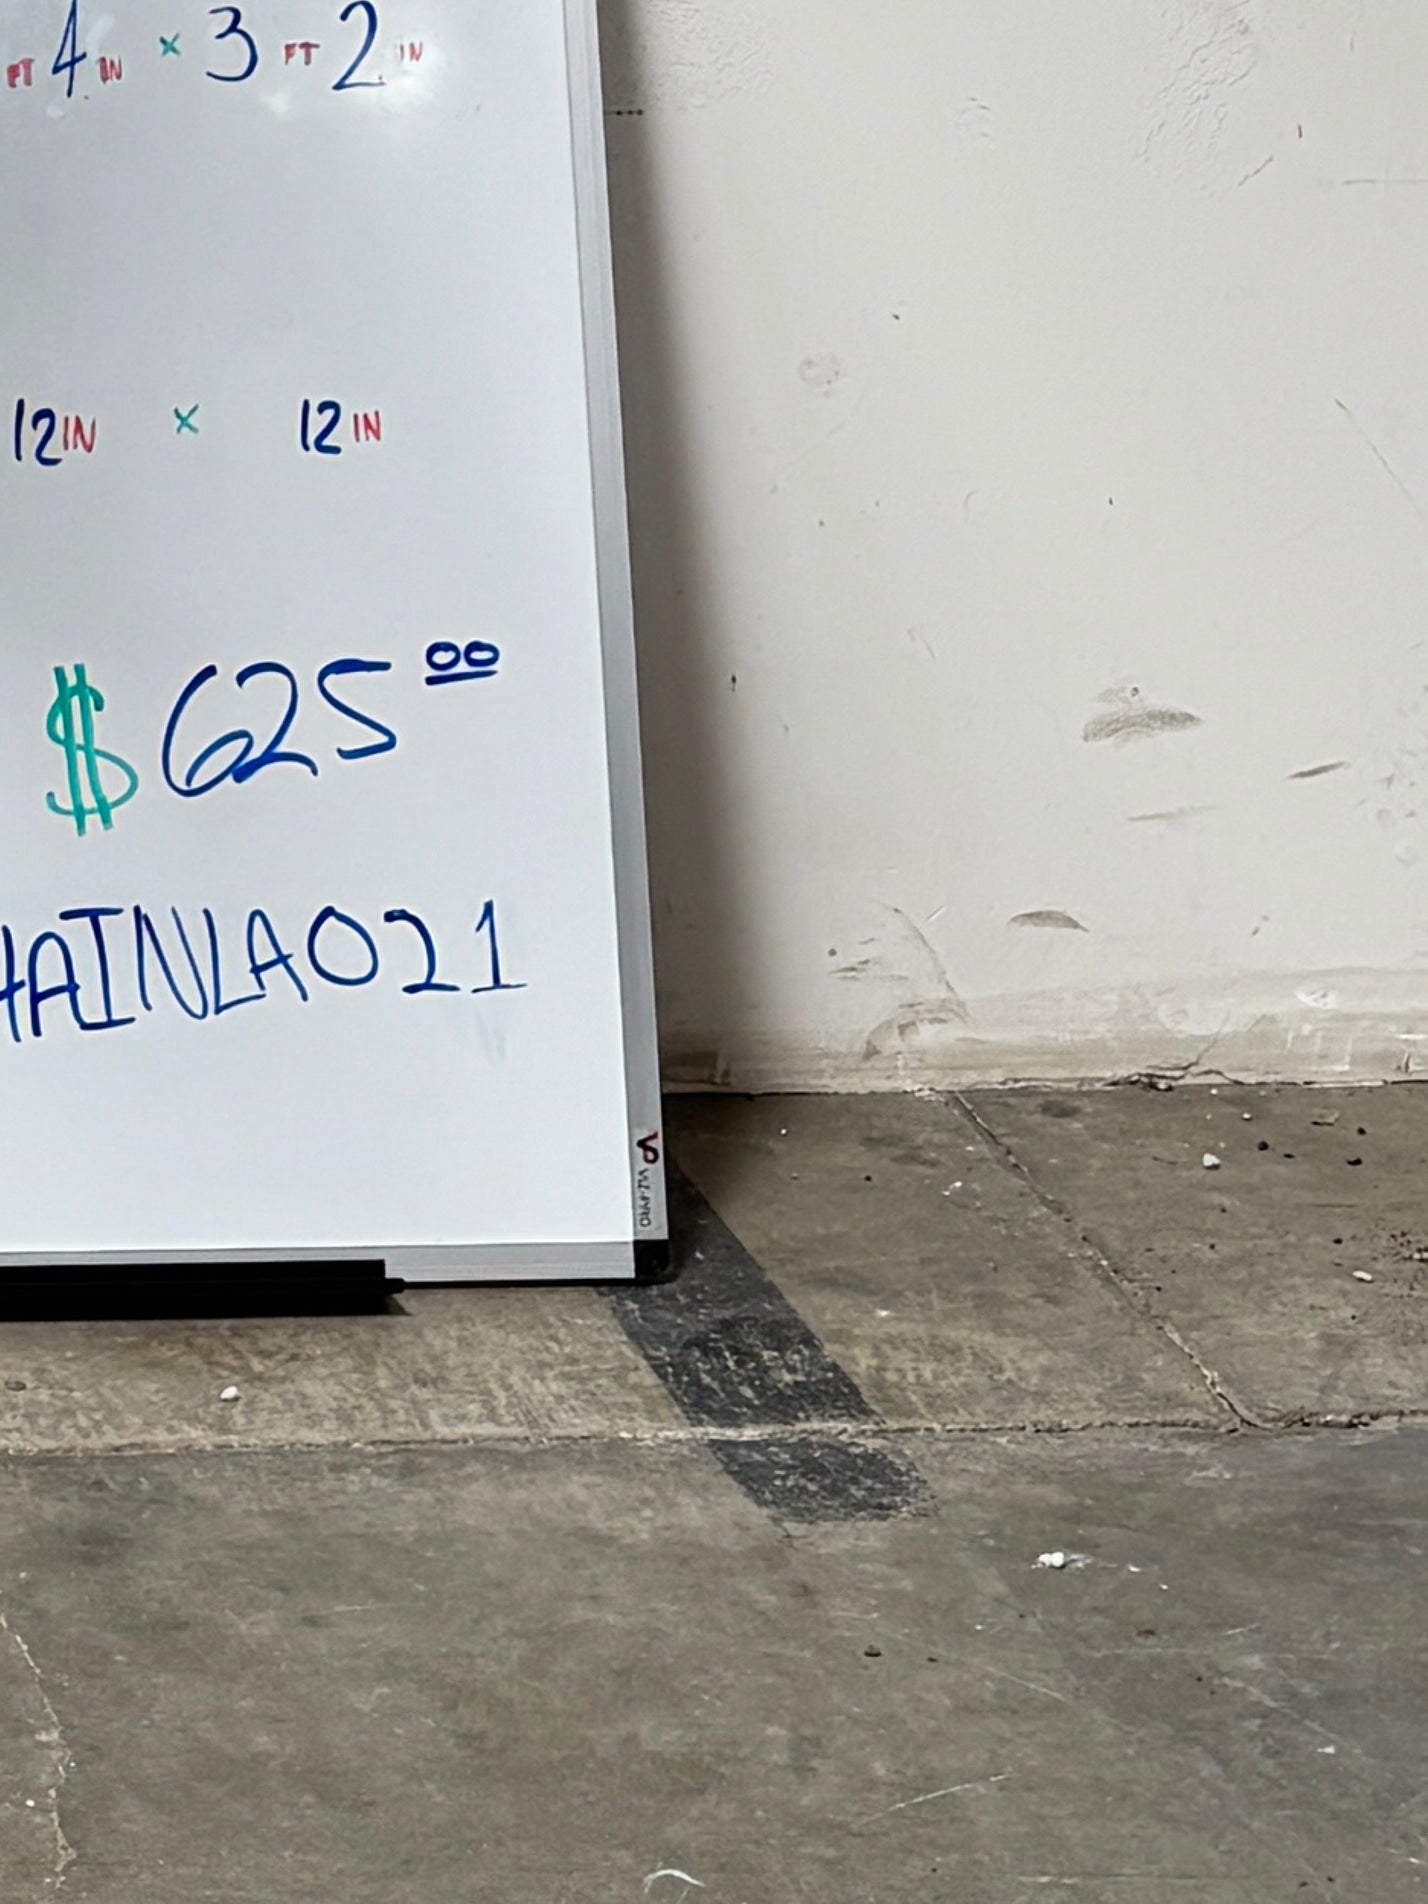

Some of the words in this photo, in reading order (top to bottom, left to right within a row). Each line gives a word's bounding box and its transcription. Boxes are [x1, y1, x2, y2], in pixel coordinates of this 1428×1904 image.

[99, 57, 123, 82] IN
[206, 6, 260, 82] 3
[284, 42, 320, 66] FT
[332, 0, 386, 92] 2
